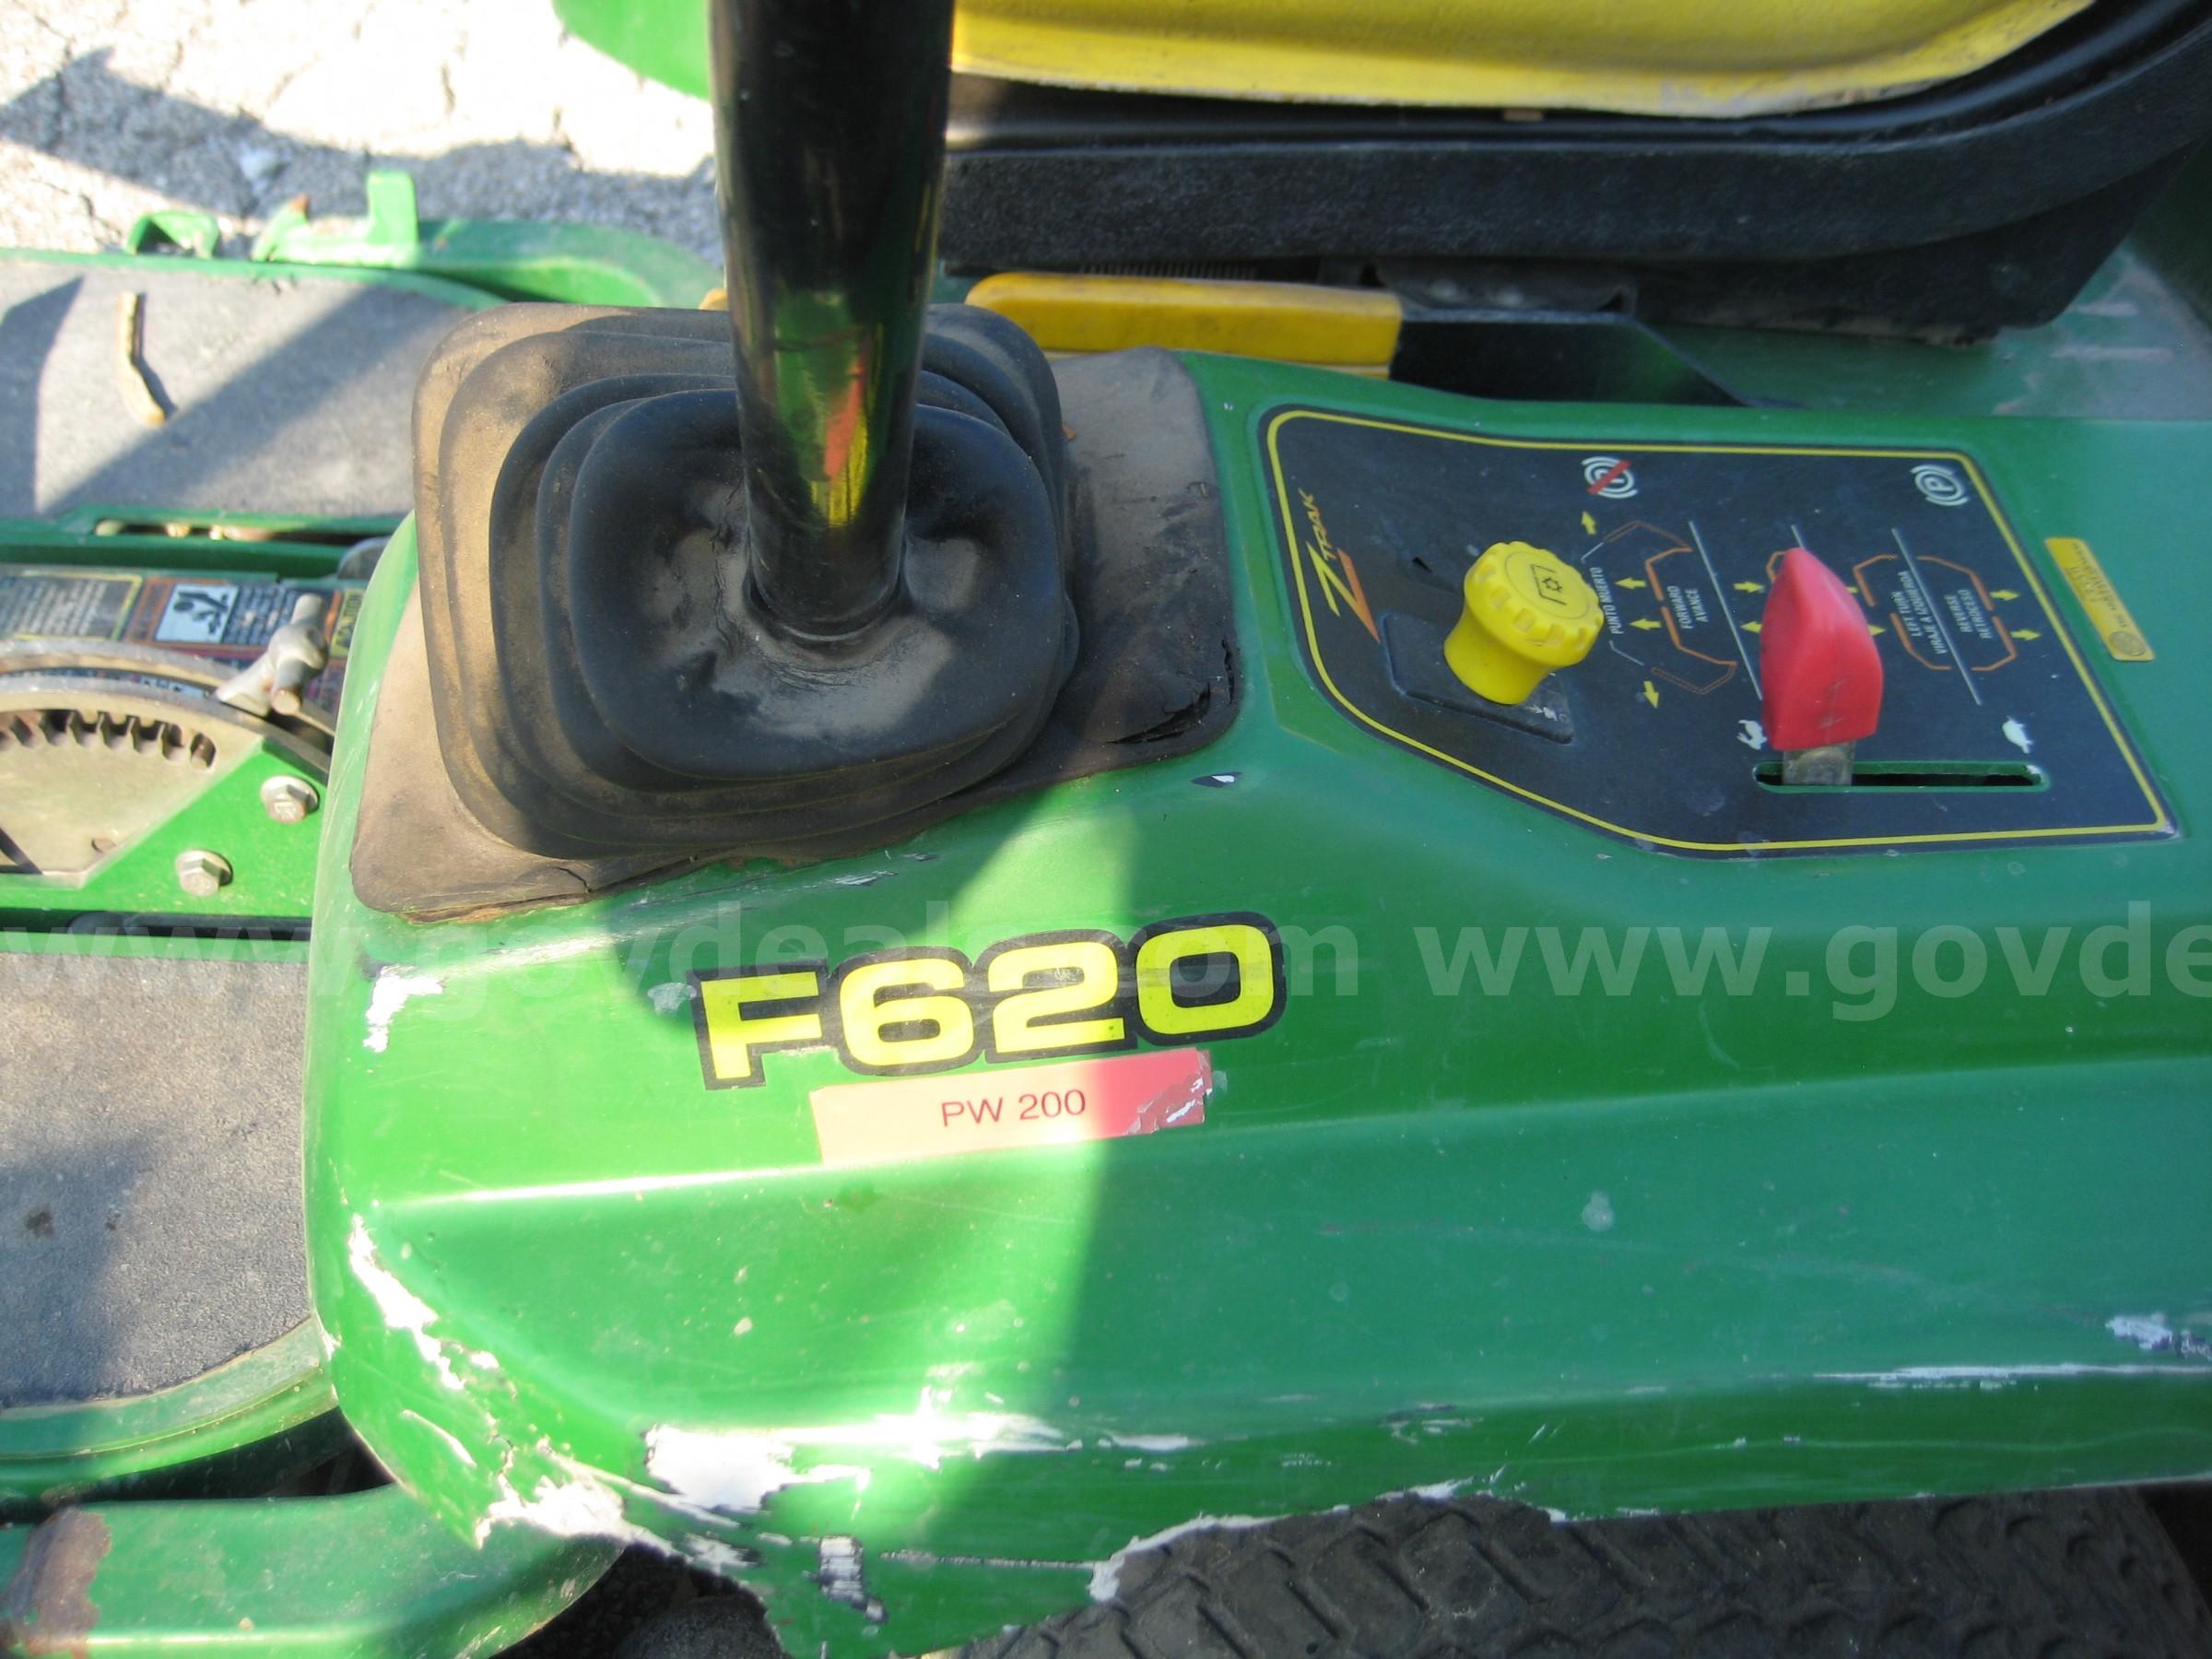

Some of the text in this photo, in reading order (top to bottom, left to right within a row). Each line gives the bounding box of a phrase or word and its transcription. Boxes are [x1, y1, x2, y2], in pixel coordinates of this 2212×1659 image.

[1589, 567, 1624, 634] PUNTO MUERTO
[1666, 585, 1694, 629] FORWARD
[1684, 589, 1709, 622] AVANCE
[1890, 591, 1923, 637] LEFT TURN
[1944, 594, 1972, 632] REVERSE
[691, 914, 1284, 1087] F620
[940, 1088, 1086, 1127] PW 200
